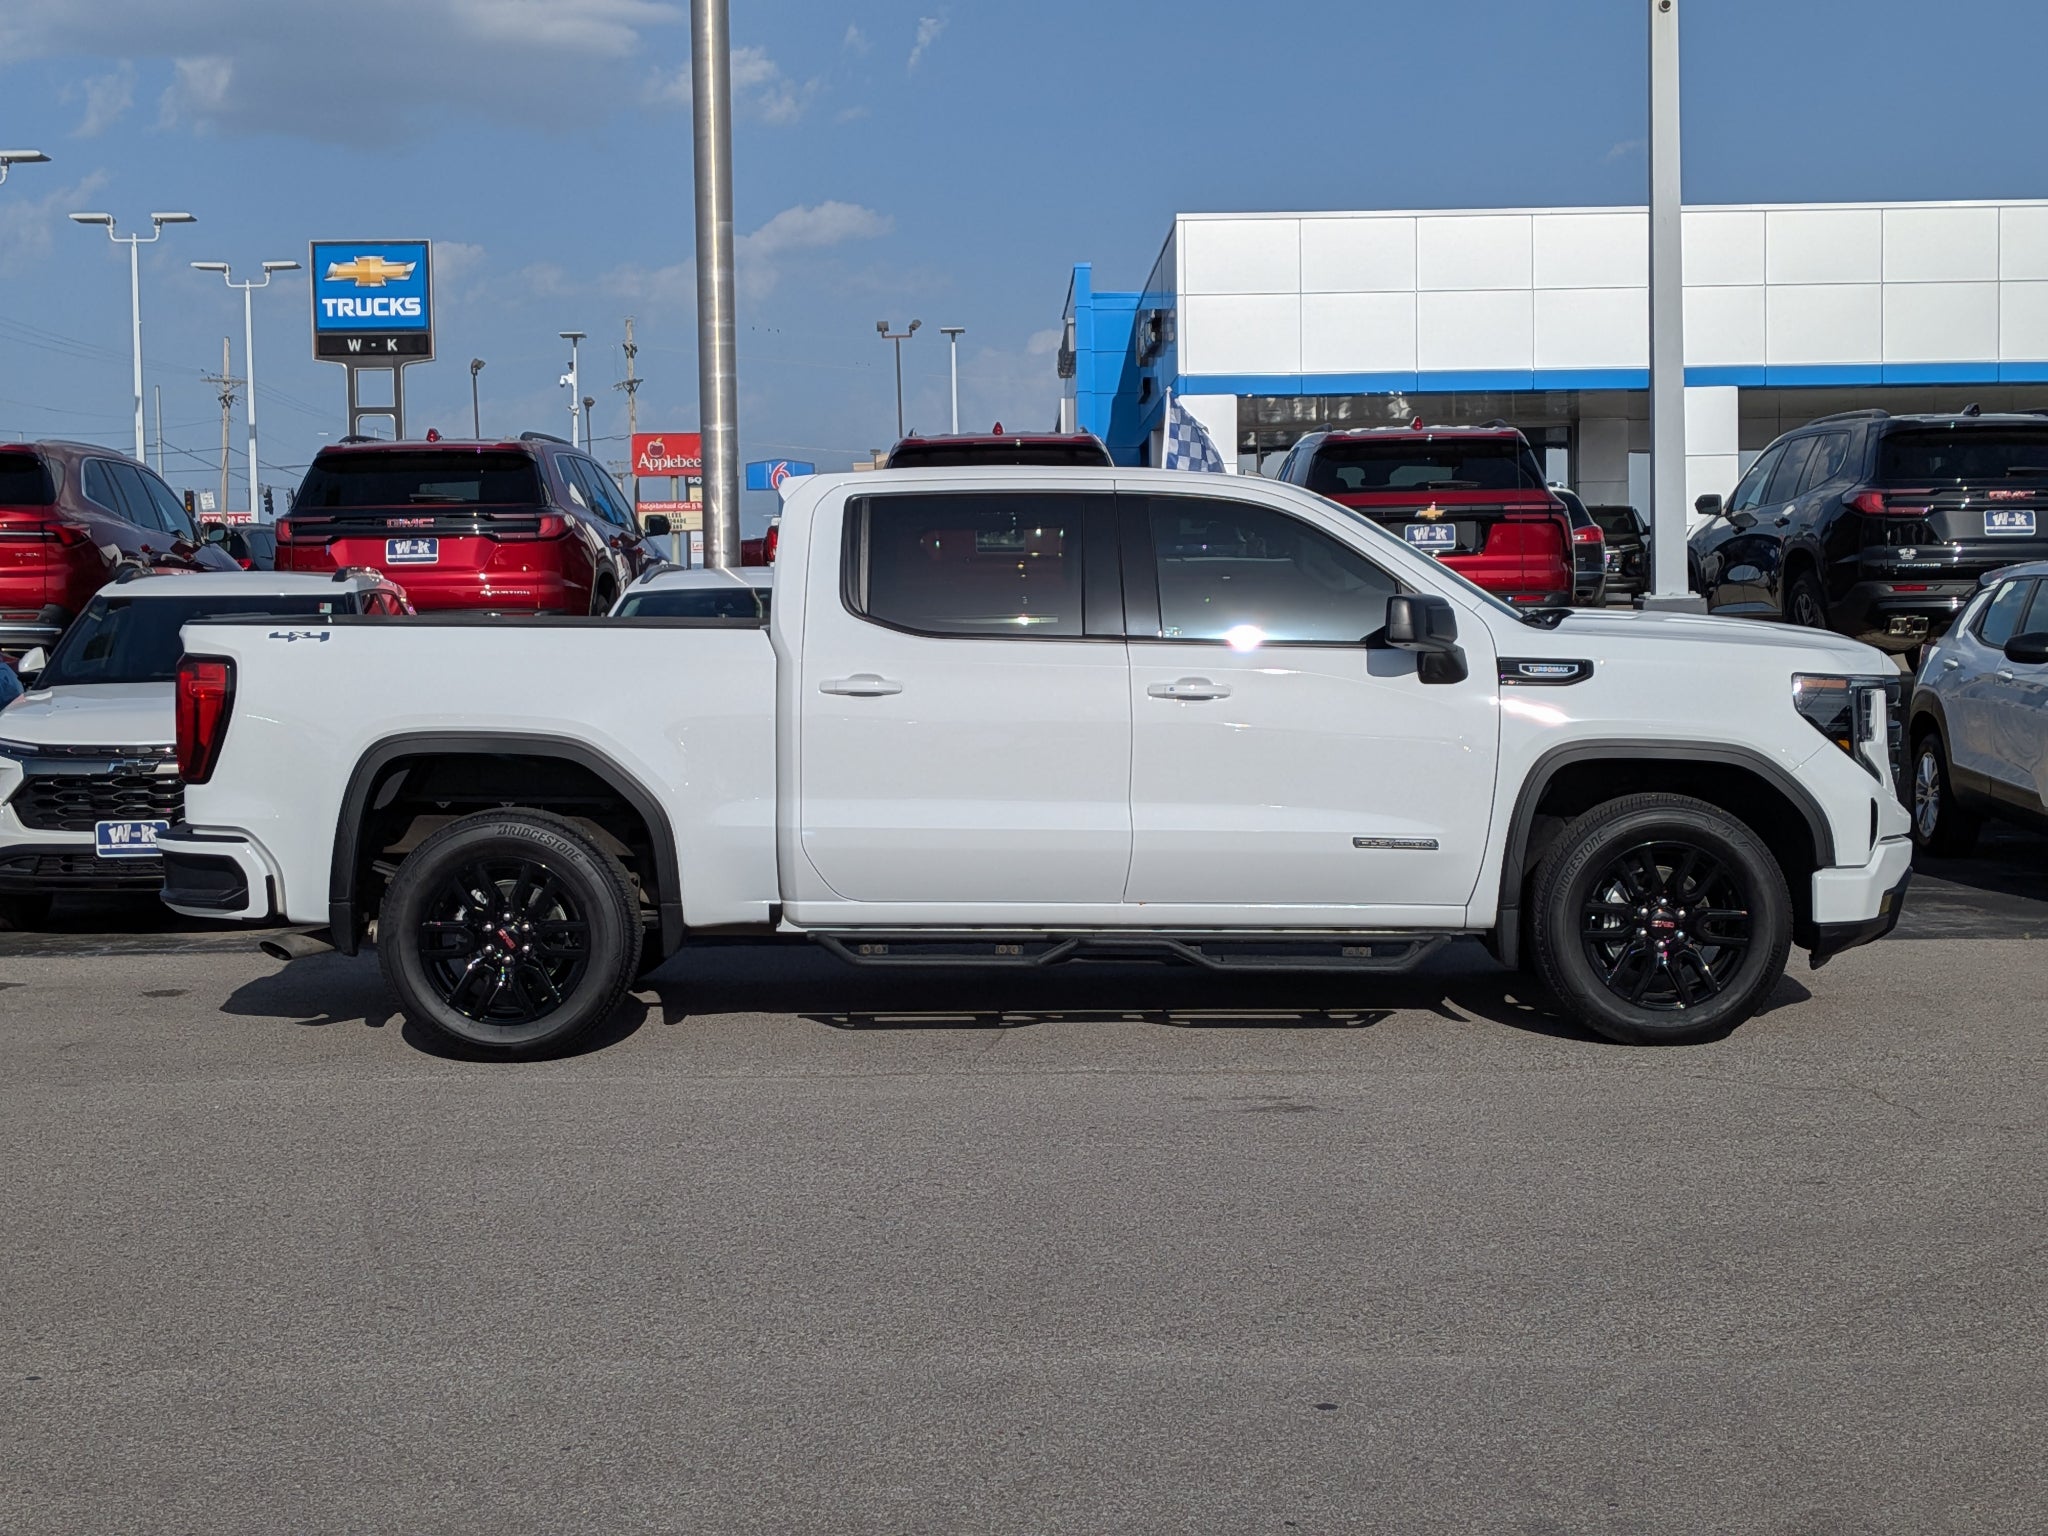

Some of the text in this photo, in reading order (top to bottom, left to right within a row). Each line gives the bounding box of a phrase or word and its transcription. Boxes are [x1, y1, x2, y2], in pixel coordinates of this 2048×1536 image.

[322, 297, 421, 317] TRUCKS
[771, 462, 791, 489] 6
[386, 518, 435, 528] GMC
[1993, 512, 2027, 526] W-K
[1413, 526, 1448, 541] W-K
[395, 540, 430, 554] W-K
[108, 823, 158, 843] W-K
[496, 823, 582, 862] BRIDGESTONE
